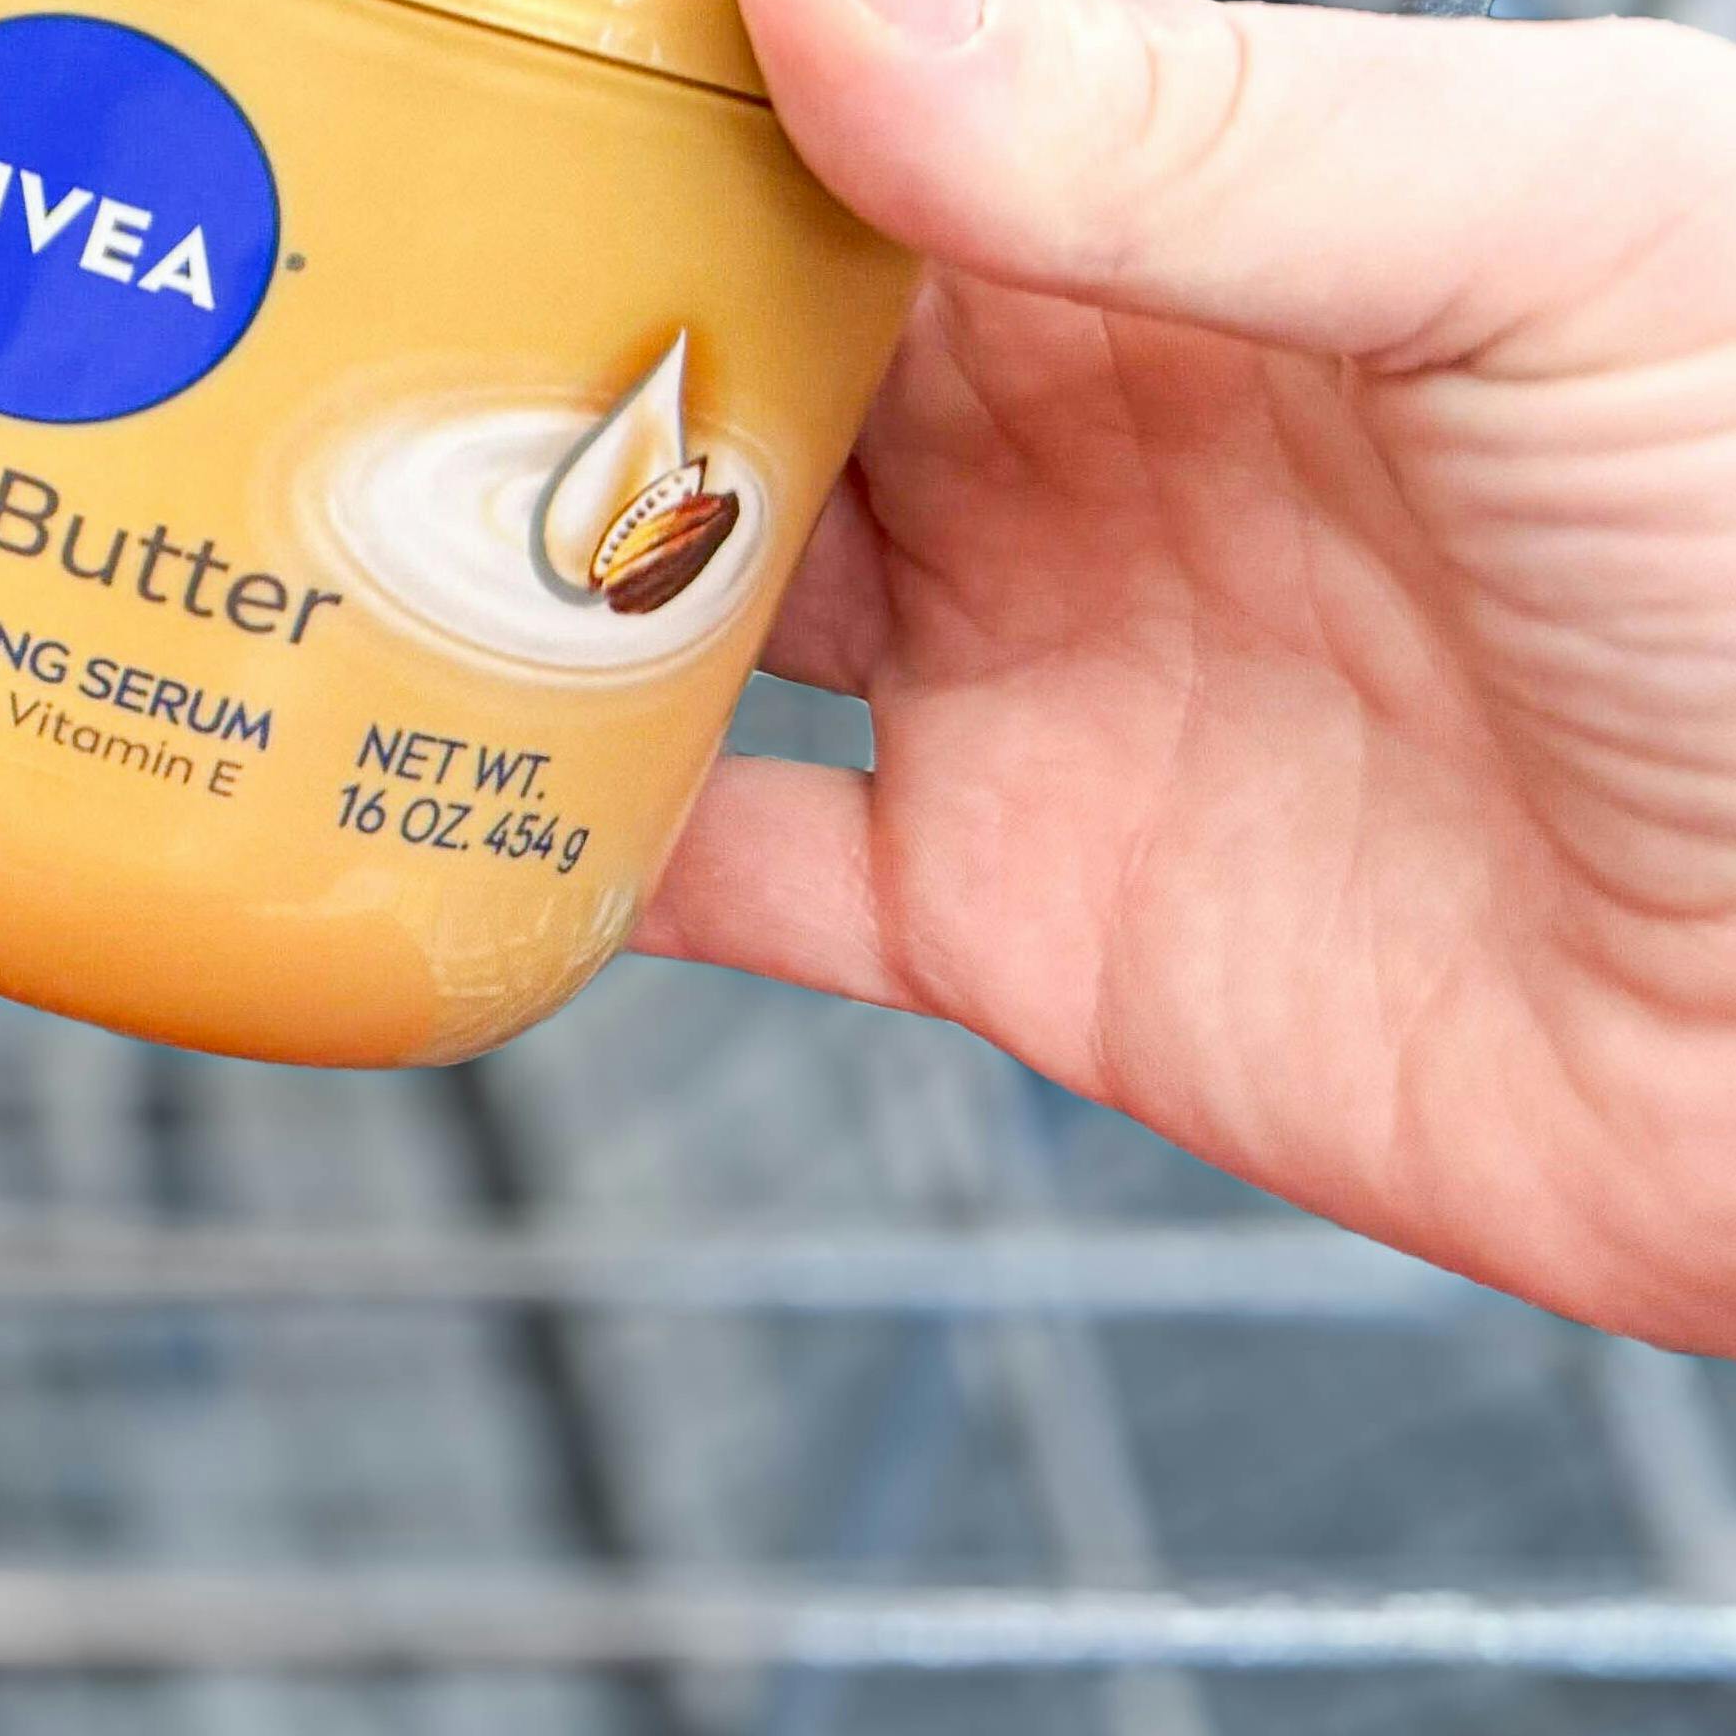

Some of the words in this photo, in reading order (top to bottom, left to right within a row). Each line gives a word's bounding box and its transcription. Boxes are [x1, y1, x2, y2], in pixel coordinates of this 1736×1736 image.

[6, 690, 196, 786] Vitamin
[207, 759, 245, 799] E
[77, 656, 273, 752] SERUM
[356, 722, 469, 786] NET
[473, 745, 551, 801] WT.
[337, 782, 388, 836] 16
[399, 796, 473, 852] OZ.
